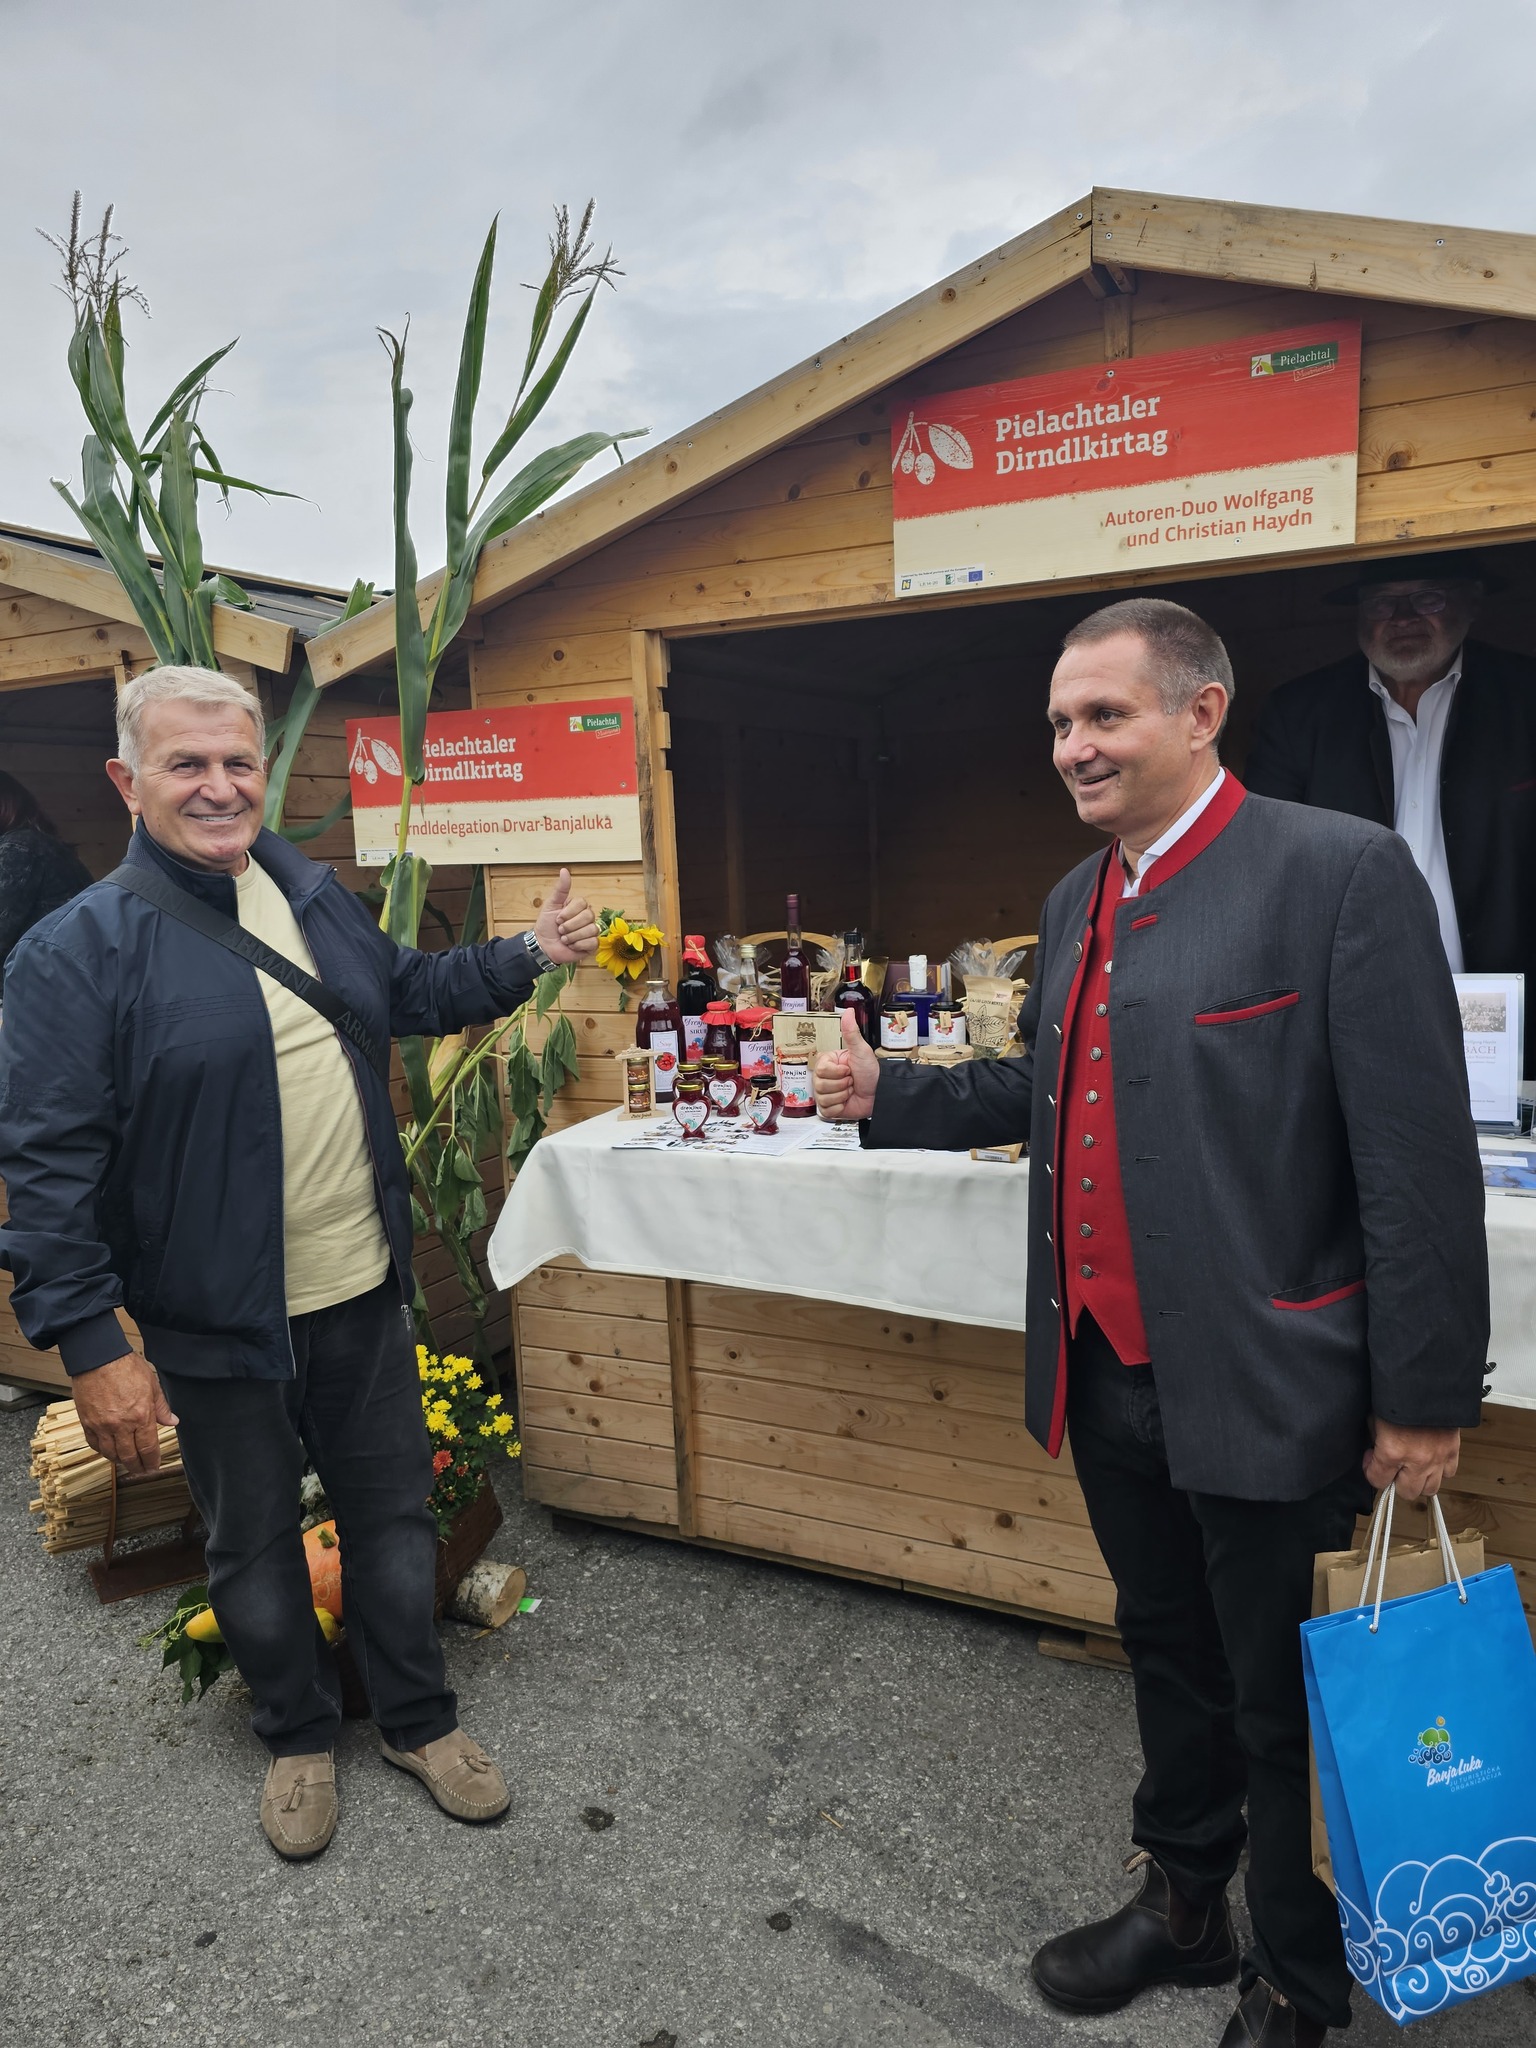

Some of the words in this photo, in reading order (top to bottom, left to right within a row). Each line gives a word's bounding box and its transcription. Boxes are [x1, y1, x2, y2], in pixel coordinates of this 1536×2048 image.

[1280, 347, 1330, 367] Pielachtal
[996, 394, 1161, 442] Pielachtaler
[996, 429, 1169, 475] Dirndlkirtag
[1105, 500, 1218, 527] Autoren-Duo
[1223, 486, 1314, 510] Wolfgang
[1126, 528, 1160, 547] und
[1165, 519, 1246, 542] Christian
[1252, 508, 1312, 533] Haydn
[587, 716, 617, 727] Pielachtal
[422, 734, 516, 758] ielachtaler
[394, 818, 499, 837] Drndldelegation
[503, 814, 613, 834] Drvar-Banjaluka
[217, 925, 314, 995] ARMANI
[1426, 1765, 1458, 1787] Banja
[1457, 1755, 1484, 1776] Luka
[1450, 1772, 1502, 1793] ORGANIZACIJA
